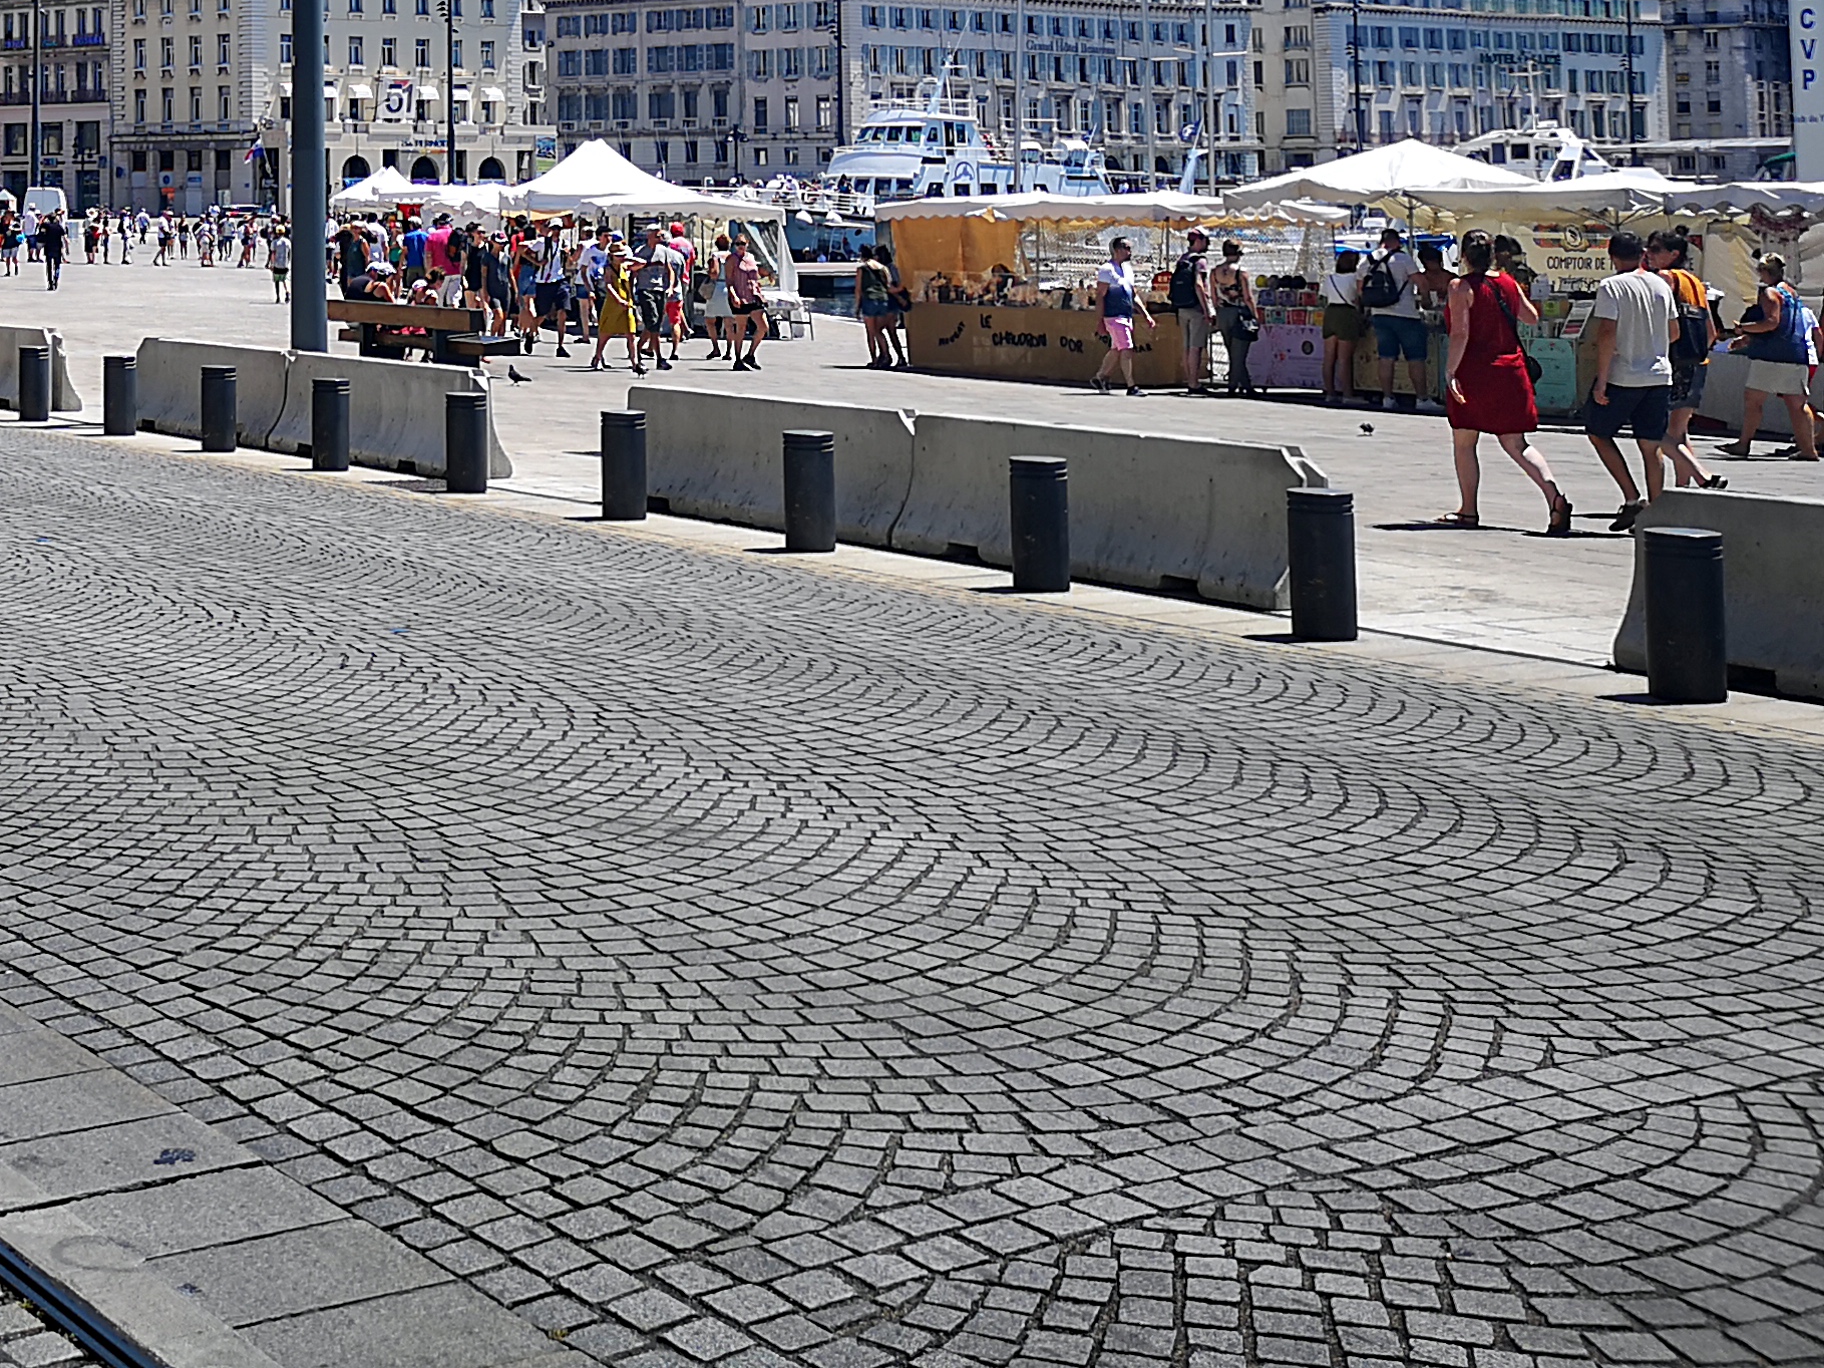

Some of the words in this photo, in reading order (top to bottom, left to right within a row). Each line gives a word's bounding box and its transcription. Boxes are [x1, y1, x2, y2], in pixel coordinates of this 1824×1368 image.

[385, 83, 413, 113] 51
[1547, 256, 1592, 271] COMPTOIR
[1594, 258, 1606, 271] DE
[980, 313, 992, 329] LE
